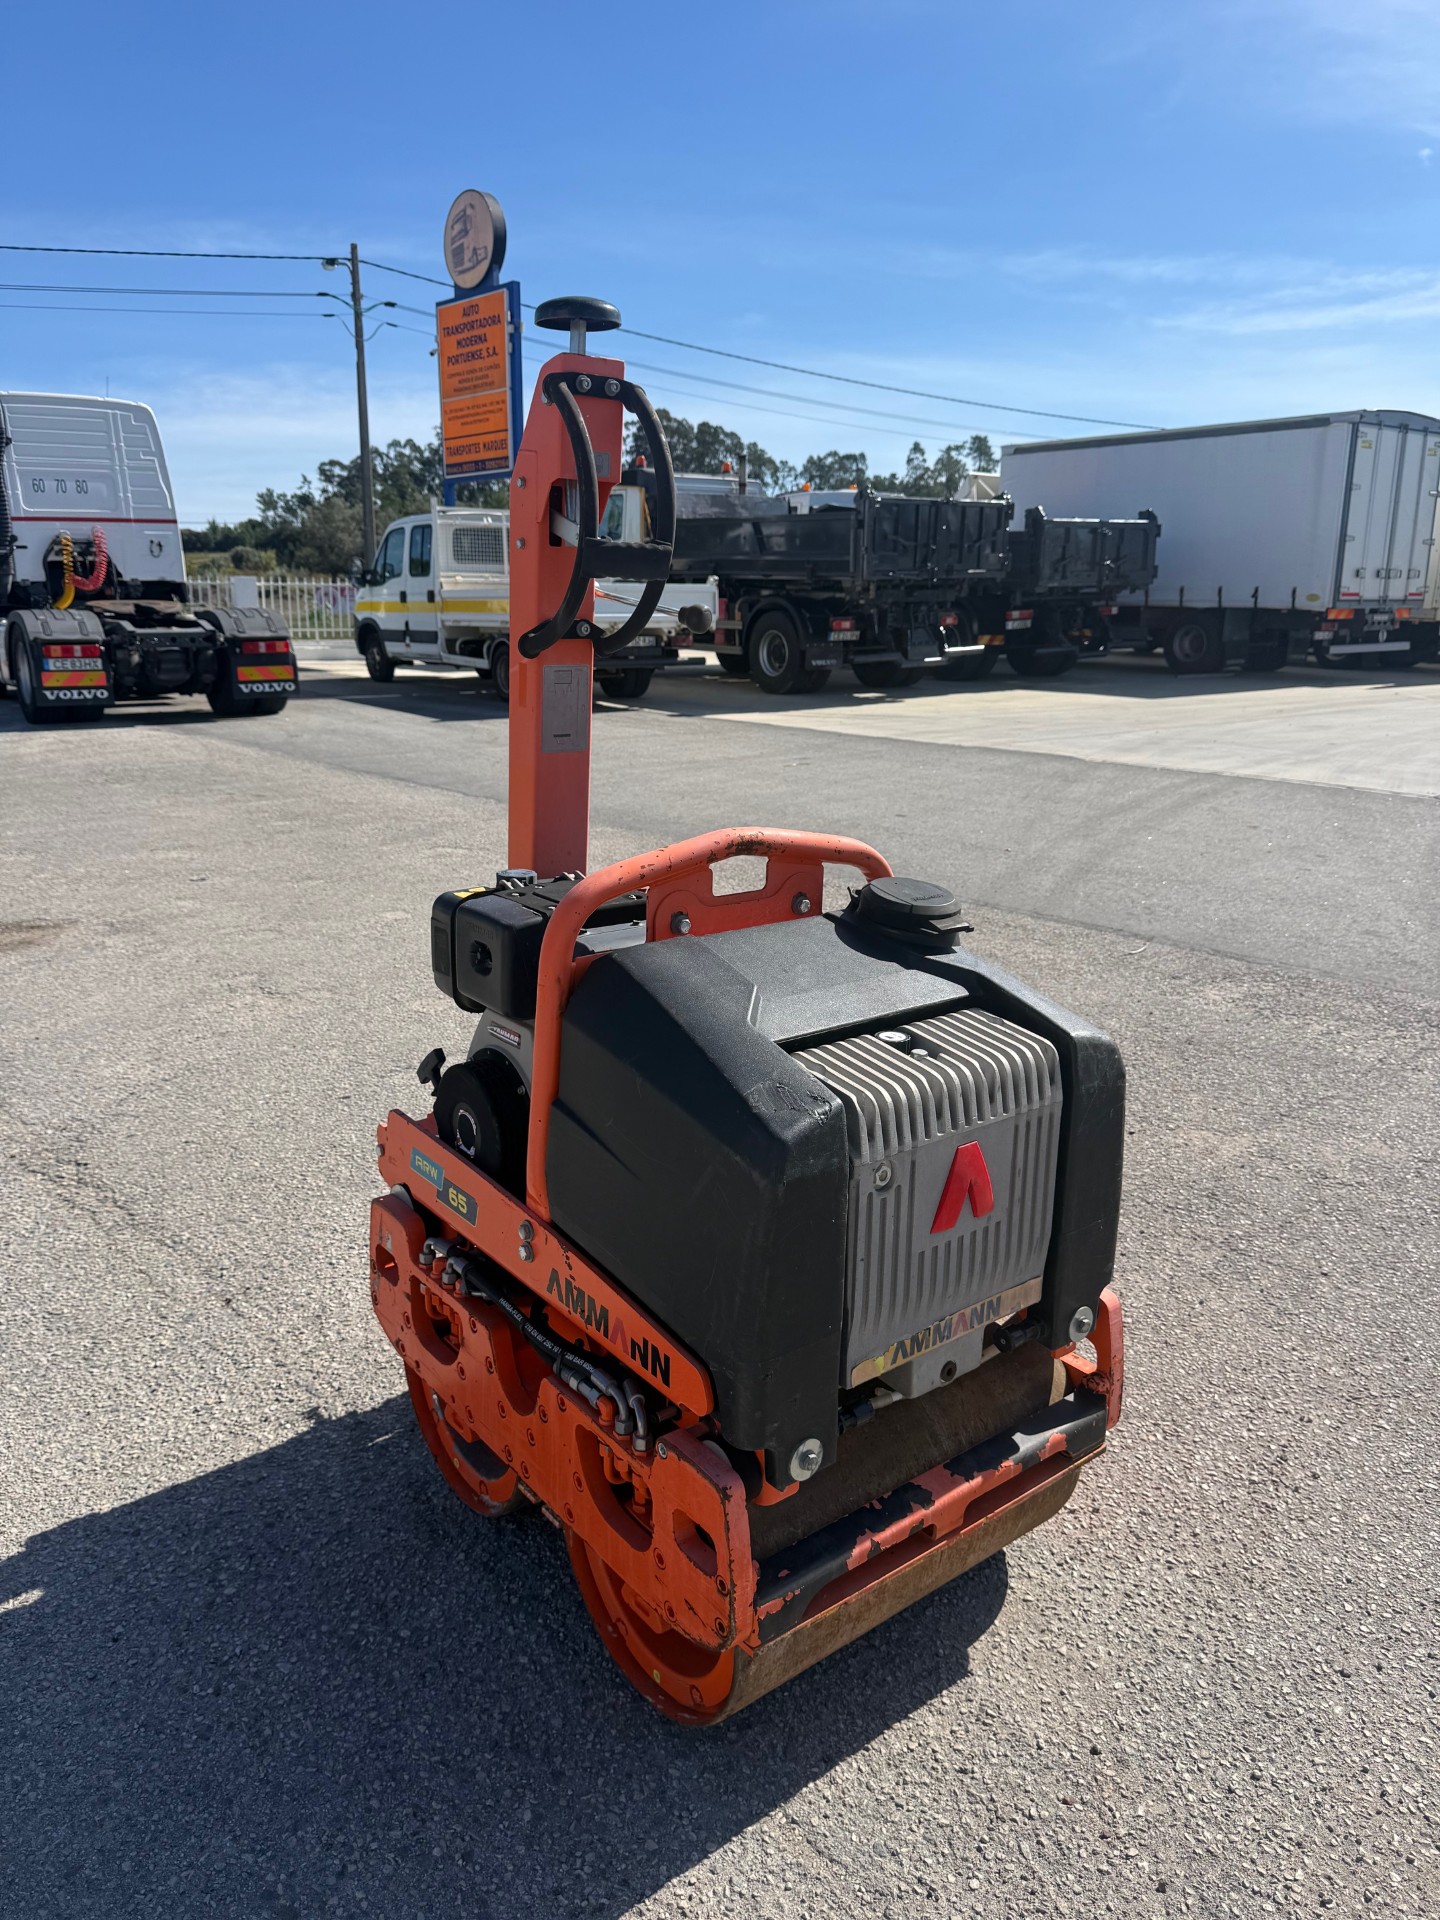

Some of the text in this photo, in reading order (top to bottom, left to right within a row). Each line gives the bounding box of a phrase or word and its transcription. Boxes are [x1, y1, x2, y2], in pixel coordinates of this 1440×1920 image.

[462, 303, 480, 318] AUTO
[443, 313, 502, 338] TRANSPORTADORA
[456, 332, 488, 350] MODERNA
[446, 438, 508, 457] TRANSPORTES MARQUES
[32, 478, 88, 495] 60 70 80
[42, 688, 109, 700] VOLVO
[238, 681, 296, 693] VOLVO
[490, 1026, 520, 1043] YANMAR
[448, 1187, 467, 1214] 65
[546, 1268, 671, 1388] AMMANN
[891, 1295, 1002, 1365] AMMANN
[573, 1356, 585, 1366] BAR
